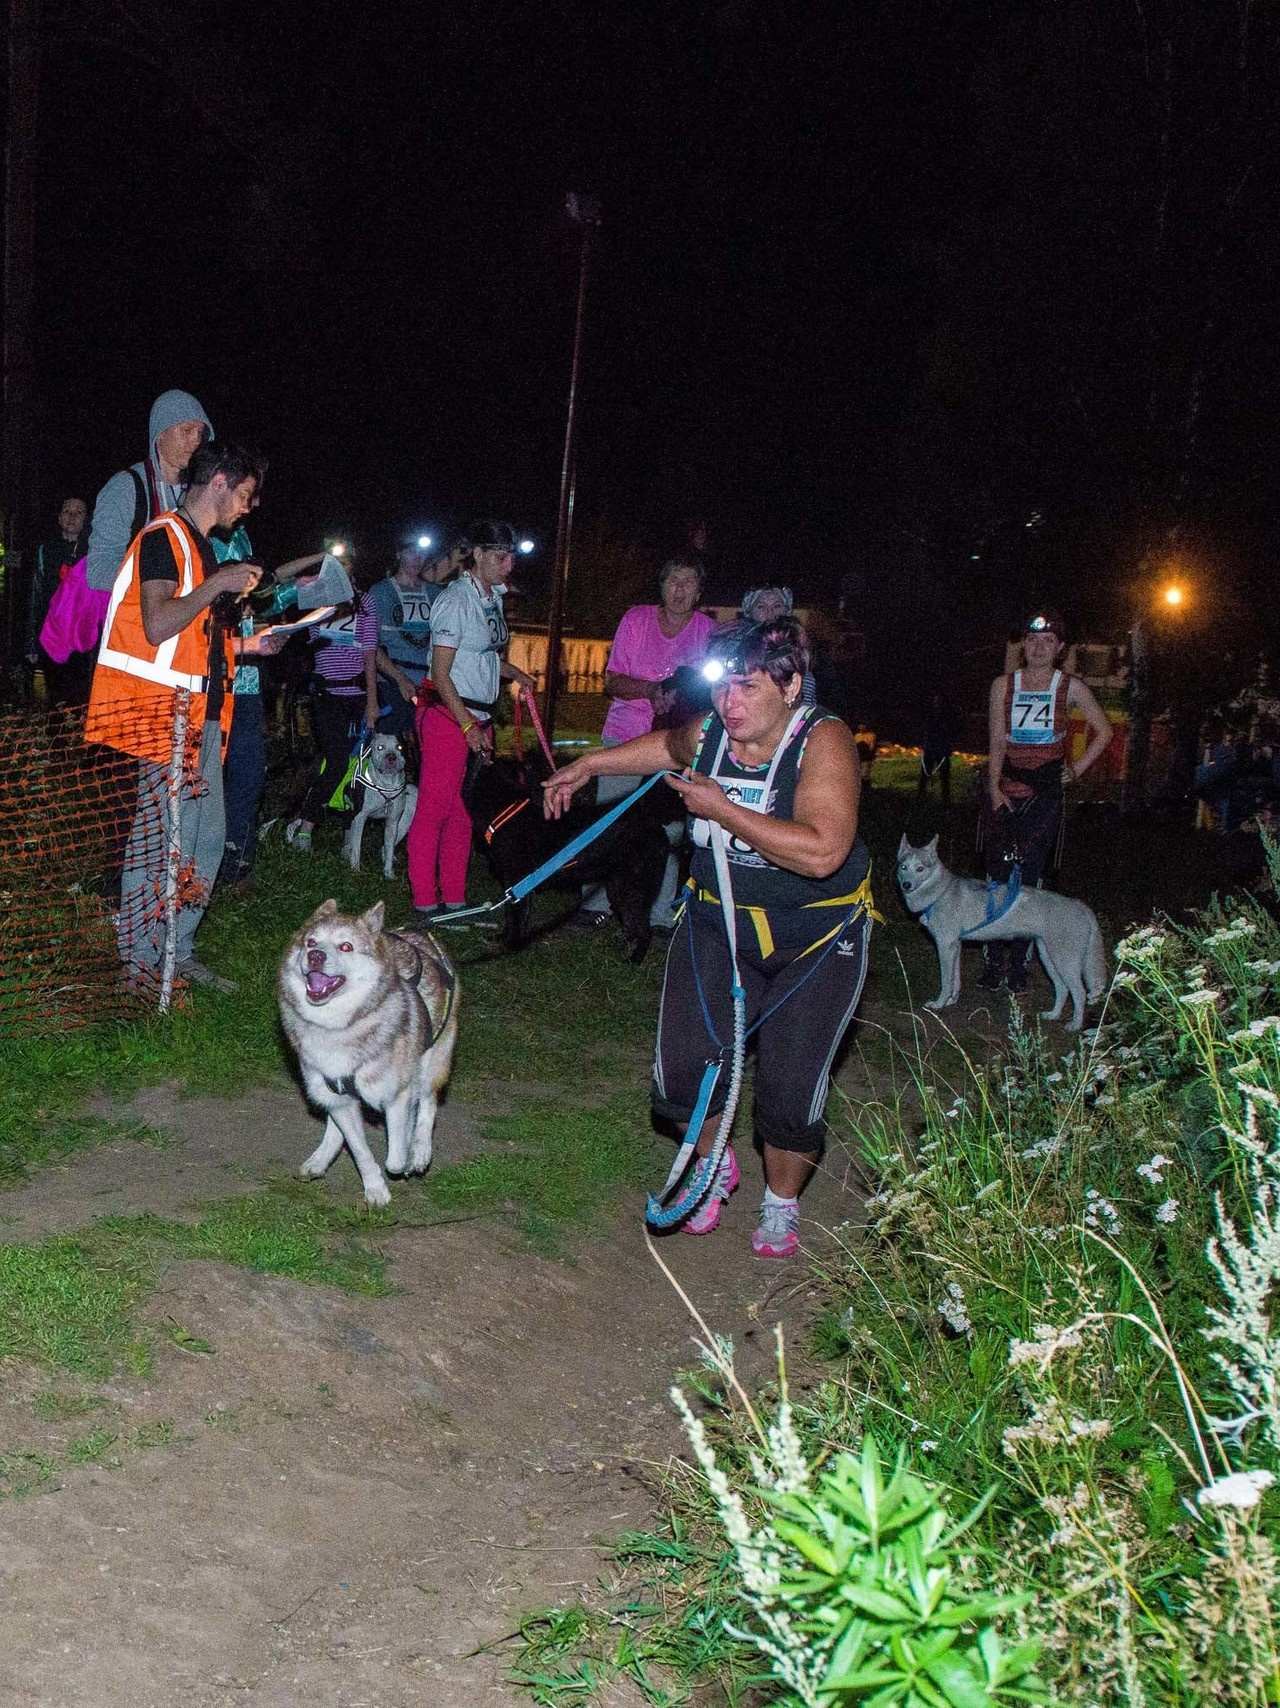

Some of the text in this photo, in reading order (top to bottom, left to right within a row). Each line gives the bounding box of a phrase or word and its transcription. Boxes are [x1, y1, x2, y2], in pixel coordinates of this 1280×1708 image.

[402, 601, 431, 620] 70
[488, 617, 508, 643] 30
[1015, 703, 1053, 728] 74
